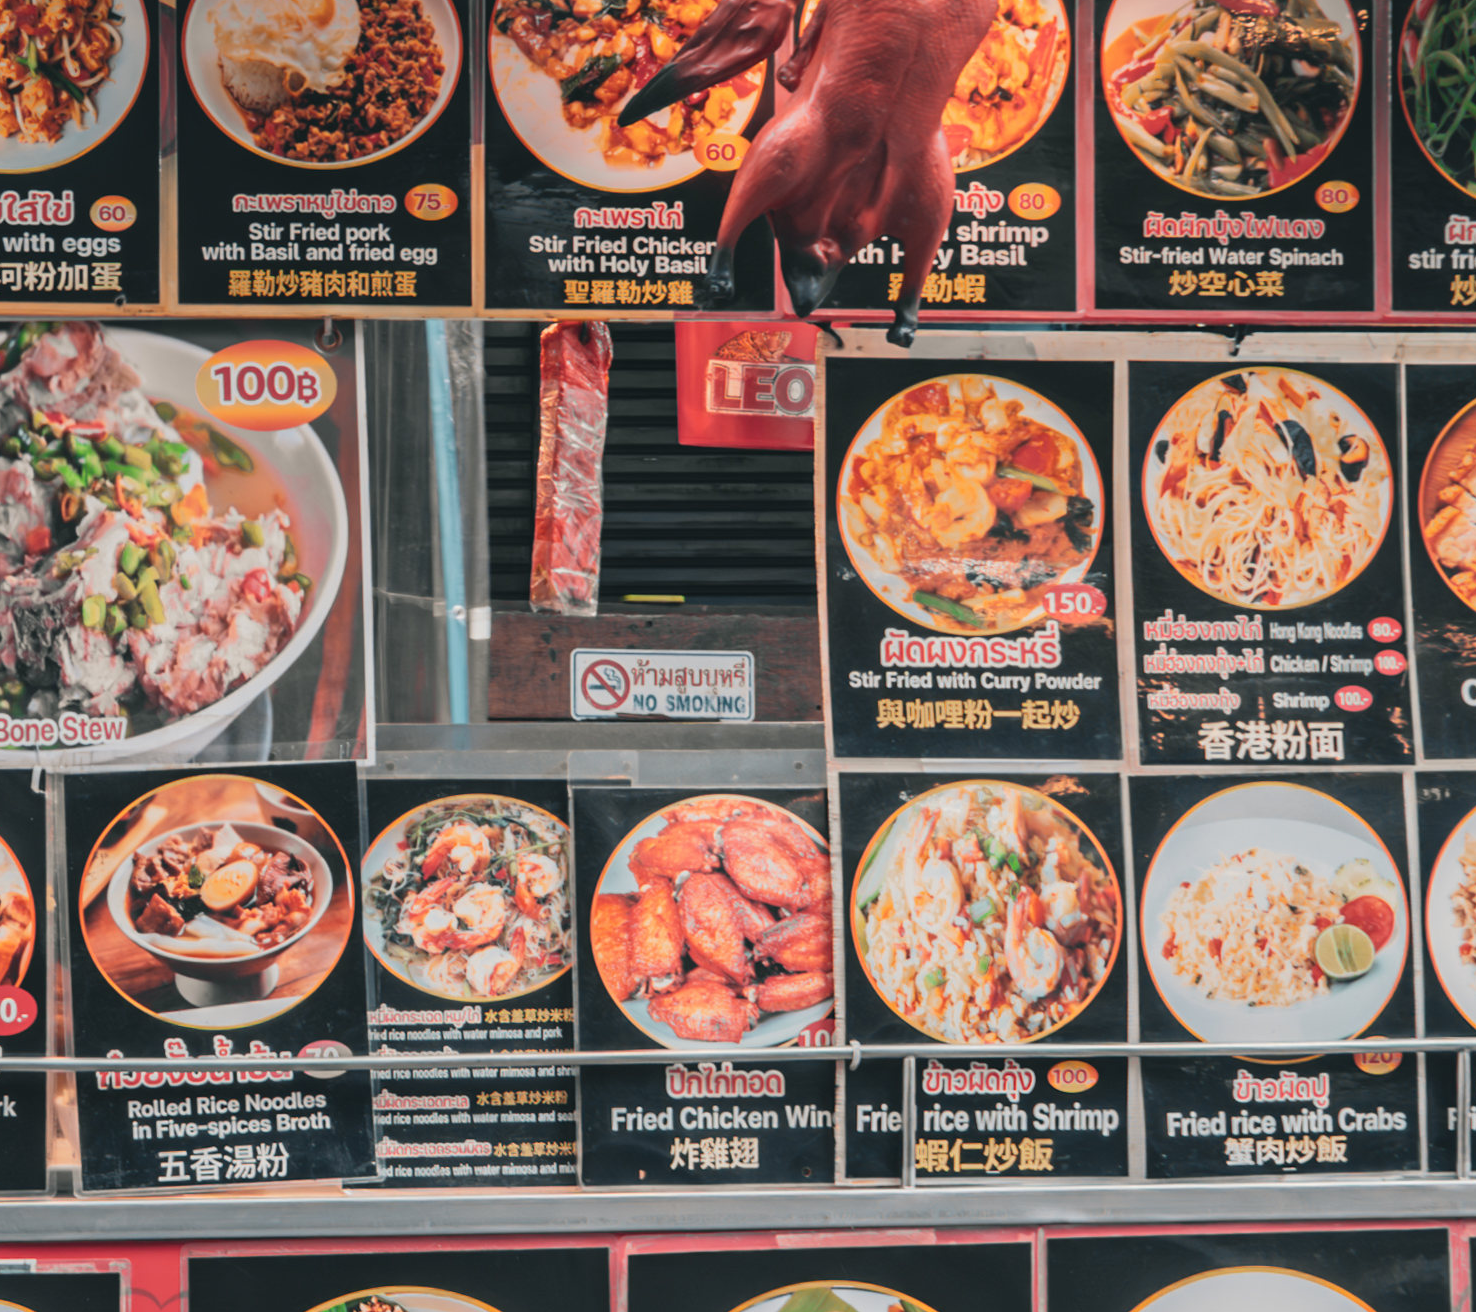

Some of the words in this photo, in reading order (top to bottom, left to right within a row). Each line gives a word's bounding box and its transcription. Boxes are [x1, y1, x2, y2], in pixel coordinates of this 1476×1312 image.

[3, 232, 54, 252] with
[63, 230, 122, 257] eggs
[1120, 246, 1204, 264] Stir-fried
[1209, 248, 1264, 265] Water
[1269, 248, 1343, 269] Spinach
[1169, 270, 1284, 297] 炒空心菜
[708, 360, 816, 416] LEO
[631, 659, 745, 696] ห้ามสูบบุหรี่
[634, 694, 657, 711] NO
[667, 695, 745, 713] SMOKING
[60, 714, 128, 744] Stew
[1198, 720, 1344, 760] 香港粉面
[1166, 1111, 1226, 1137] Fried
[1231, 1110, 1276, 1135] rice
[1281, 1107, 1333, 1133] with
[1338, 1107, 1407, 1132] Crabs
